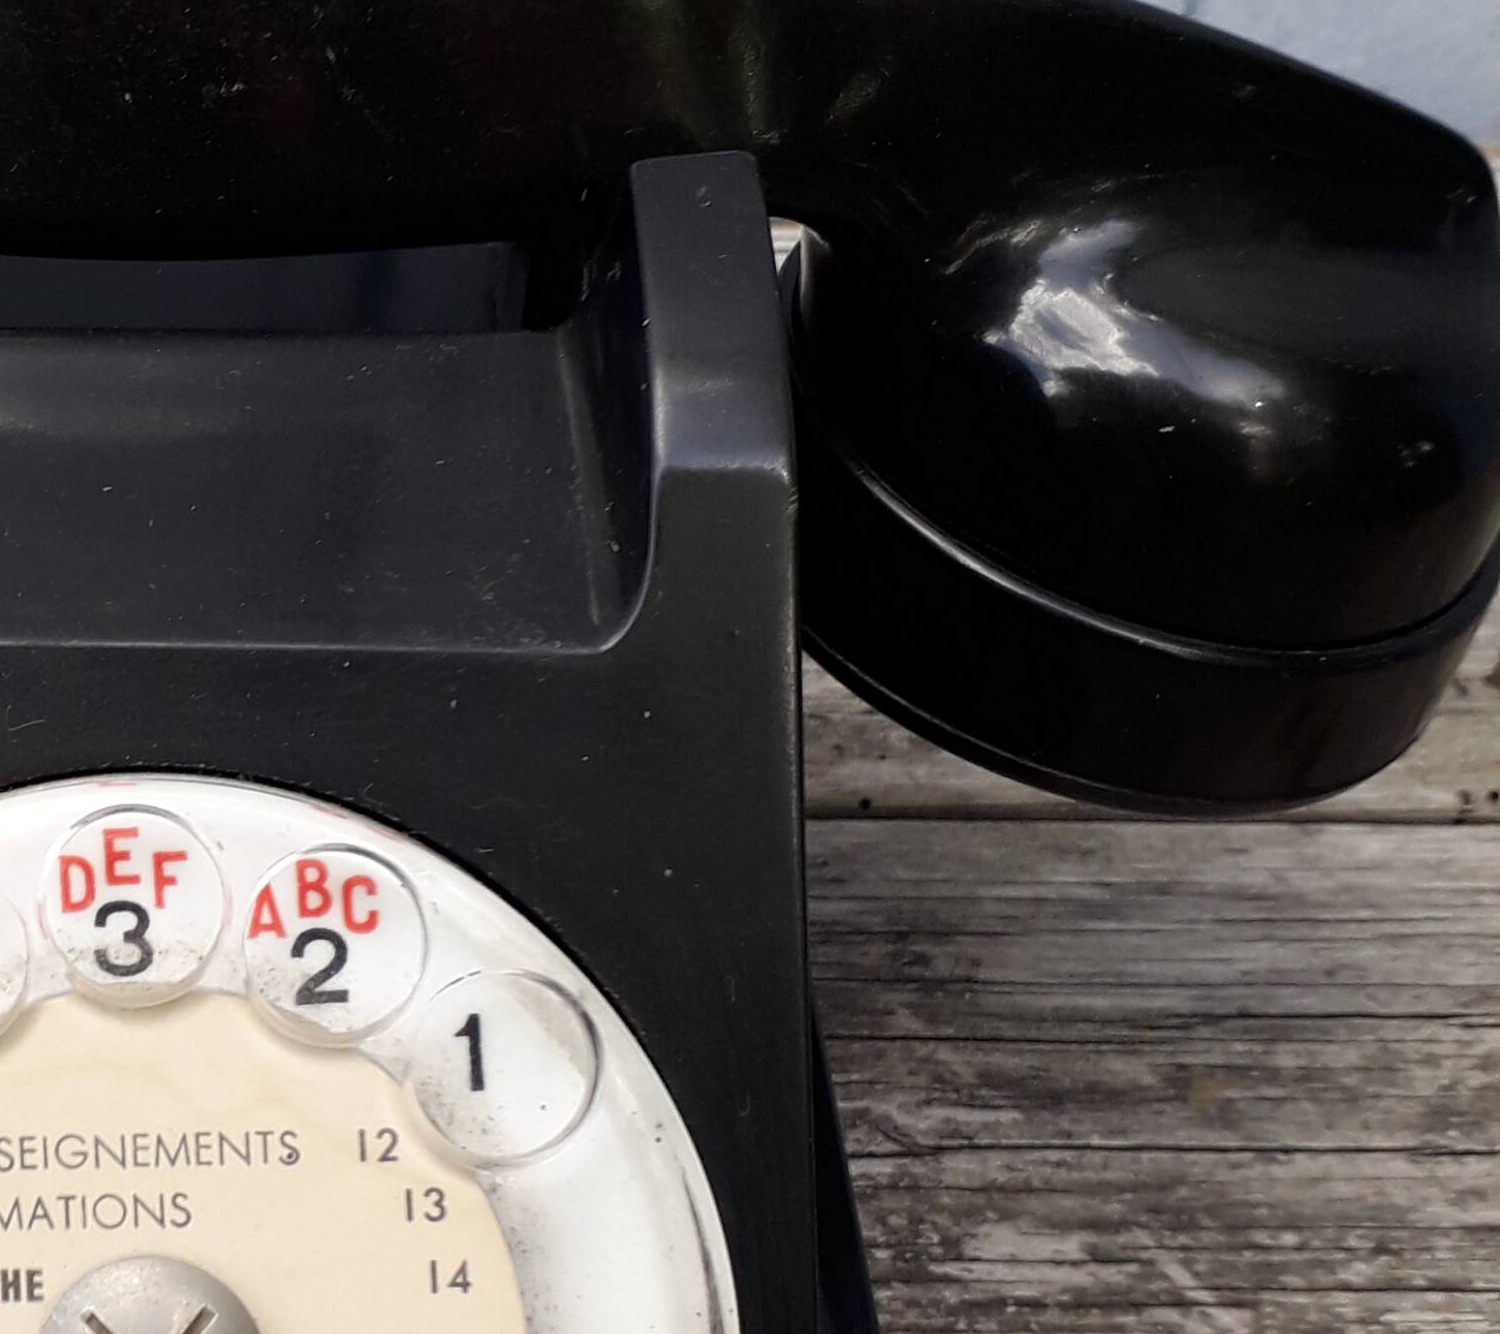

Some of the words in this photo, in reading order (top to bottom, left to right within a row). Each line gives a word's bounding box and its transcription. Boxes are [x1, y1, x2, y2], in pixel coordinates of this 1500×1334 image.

[59, 827, 187, 914] DEF
[249, 858, 379, 940] ABC
[95, 901, 153, 977] 3
[291, 928, 347, 1005] 2
[453, 1013, 484, 1092] 1
[357, 1127, 399, 1163] 12
[405, 1186, 447, 1223] 13
[429, 1259, 473, 1295] 14
